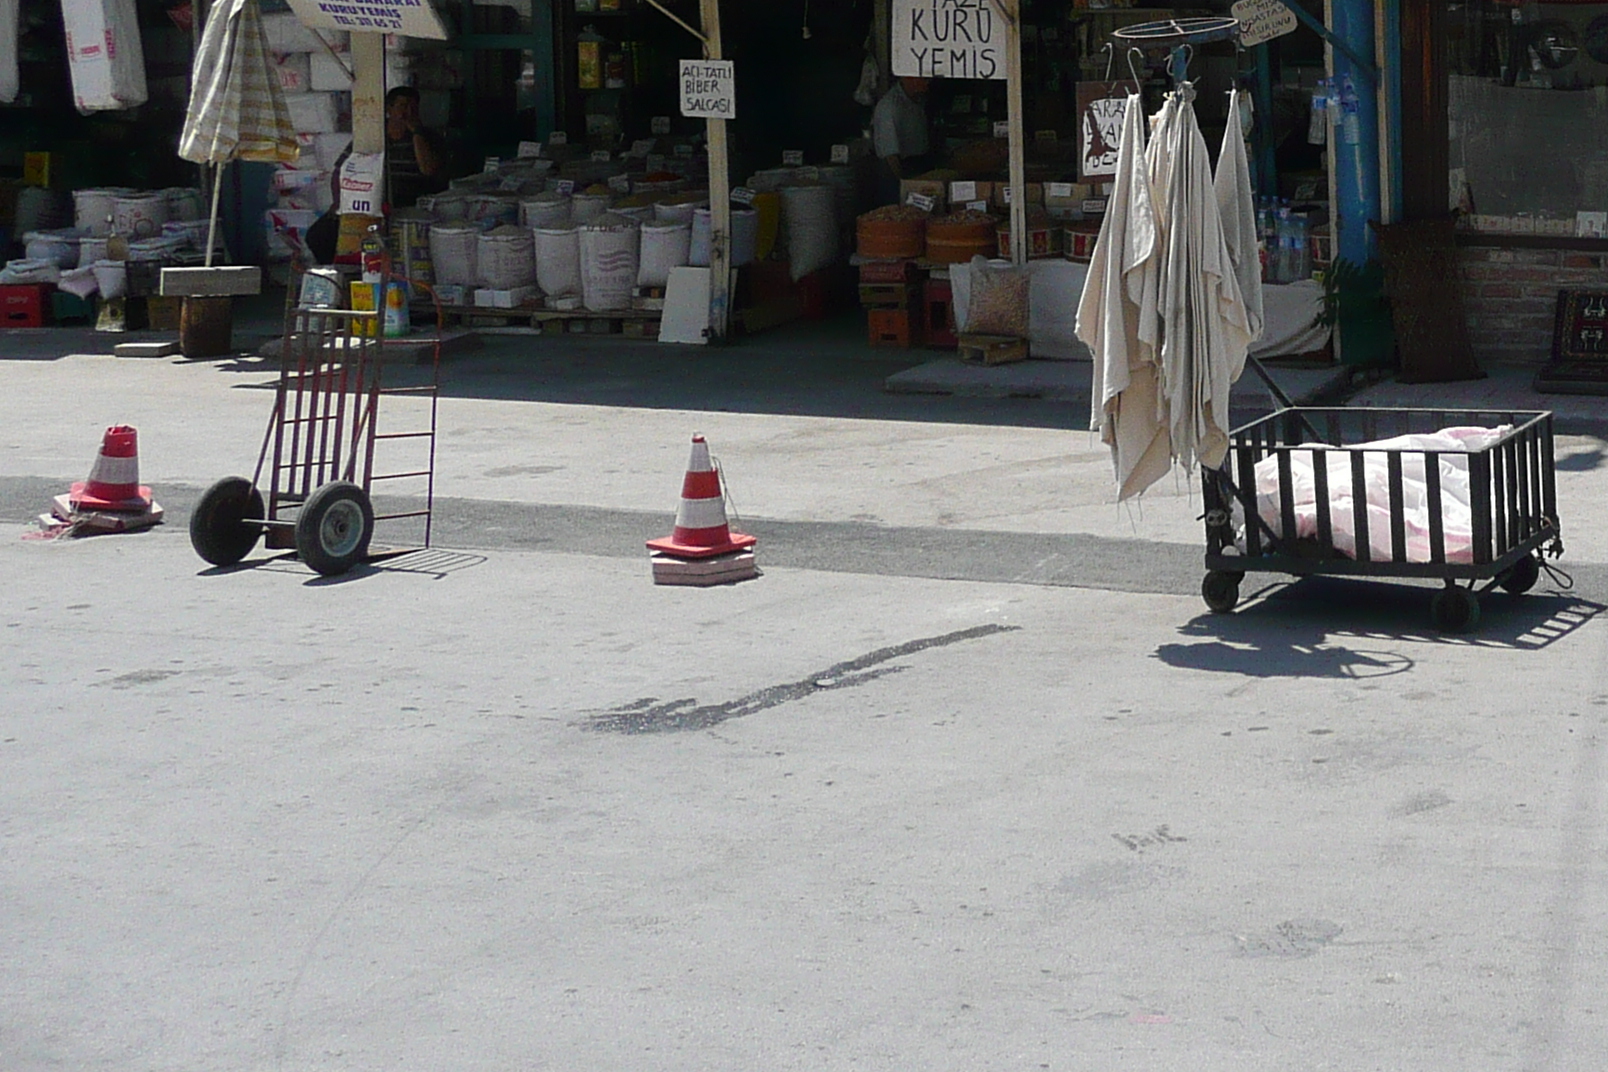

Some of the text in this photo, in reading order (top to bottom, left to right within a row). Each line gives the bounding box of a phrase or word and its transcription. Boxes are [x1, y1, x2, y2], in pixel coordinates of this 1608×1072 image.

[911, 8, 992, 43] KURU
[685, 78, 721, 95] BİBER
[352, 199, 371, 212] un
